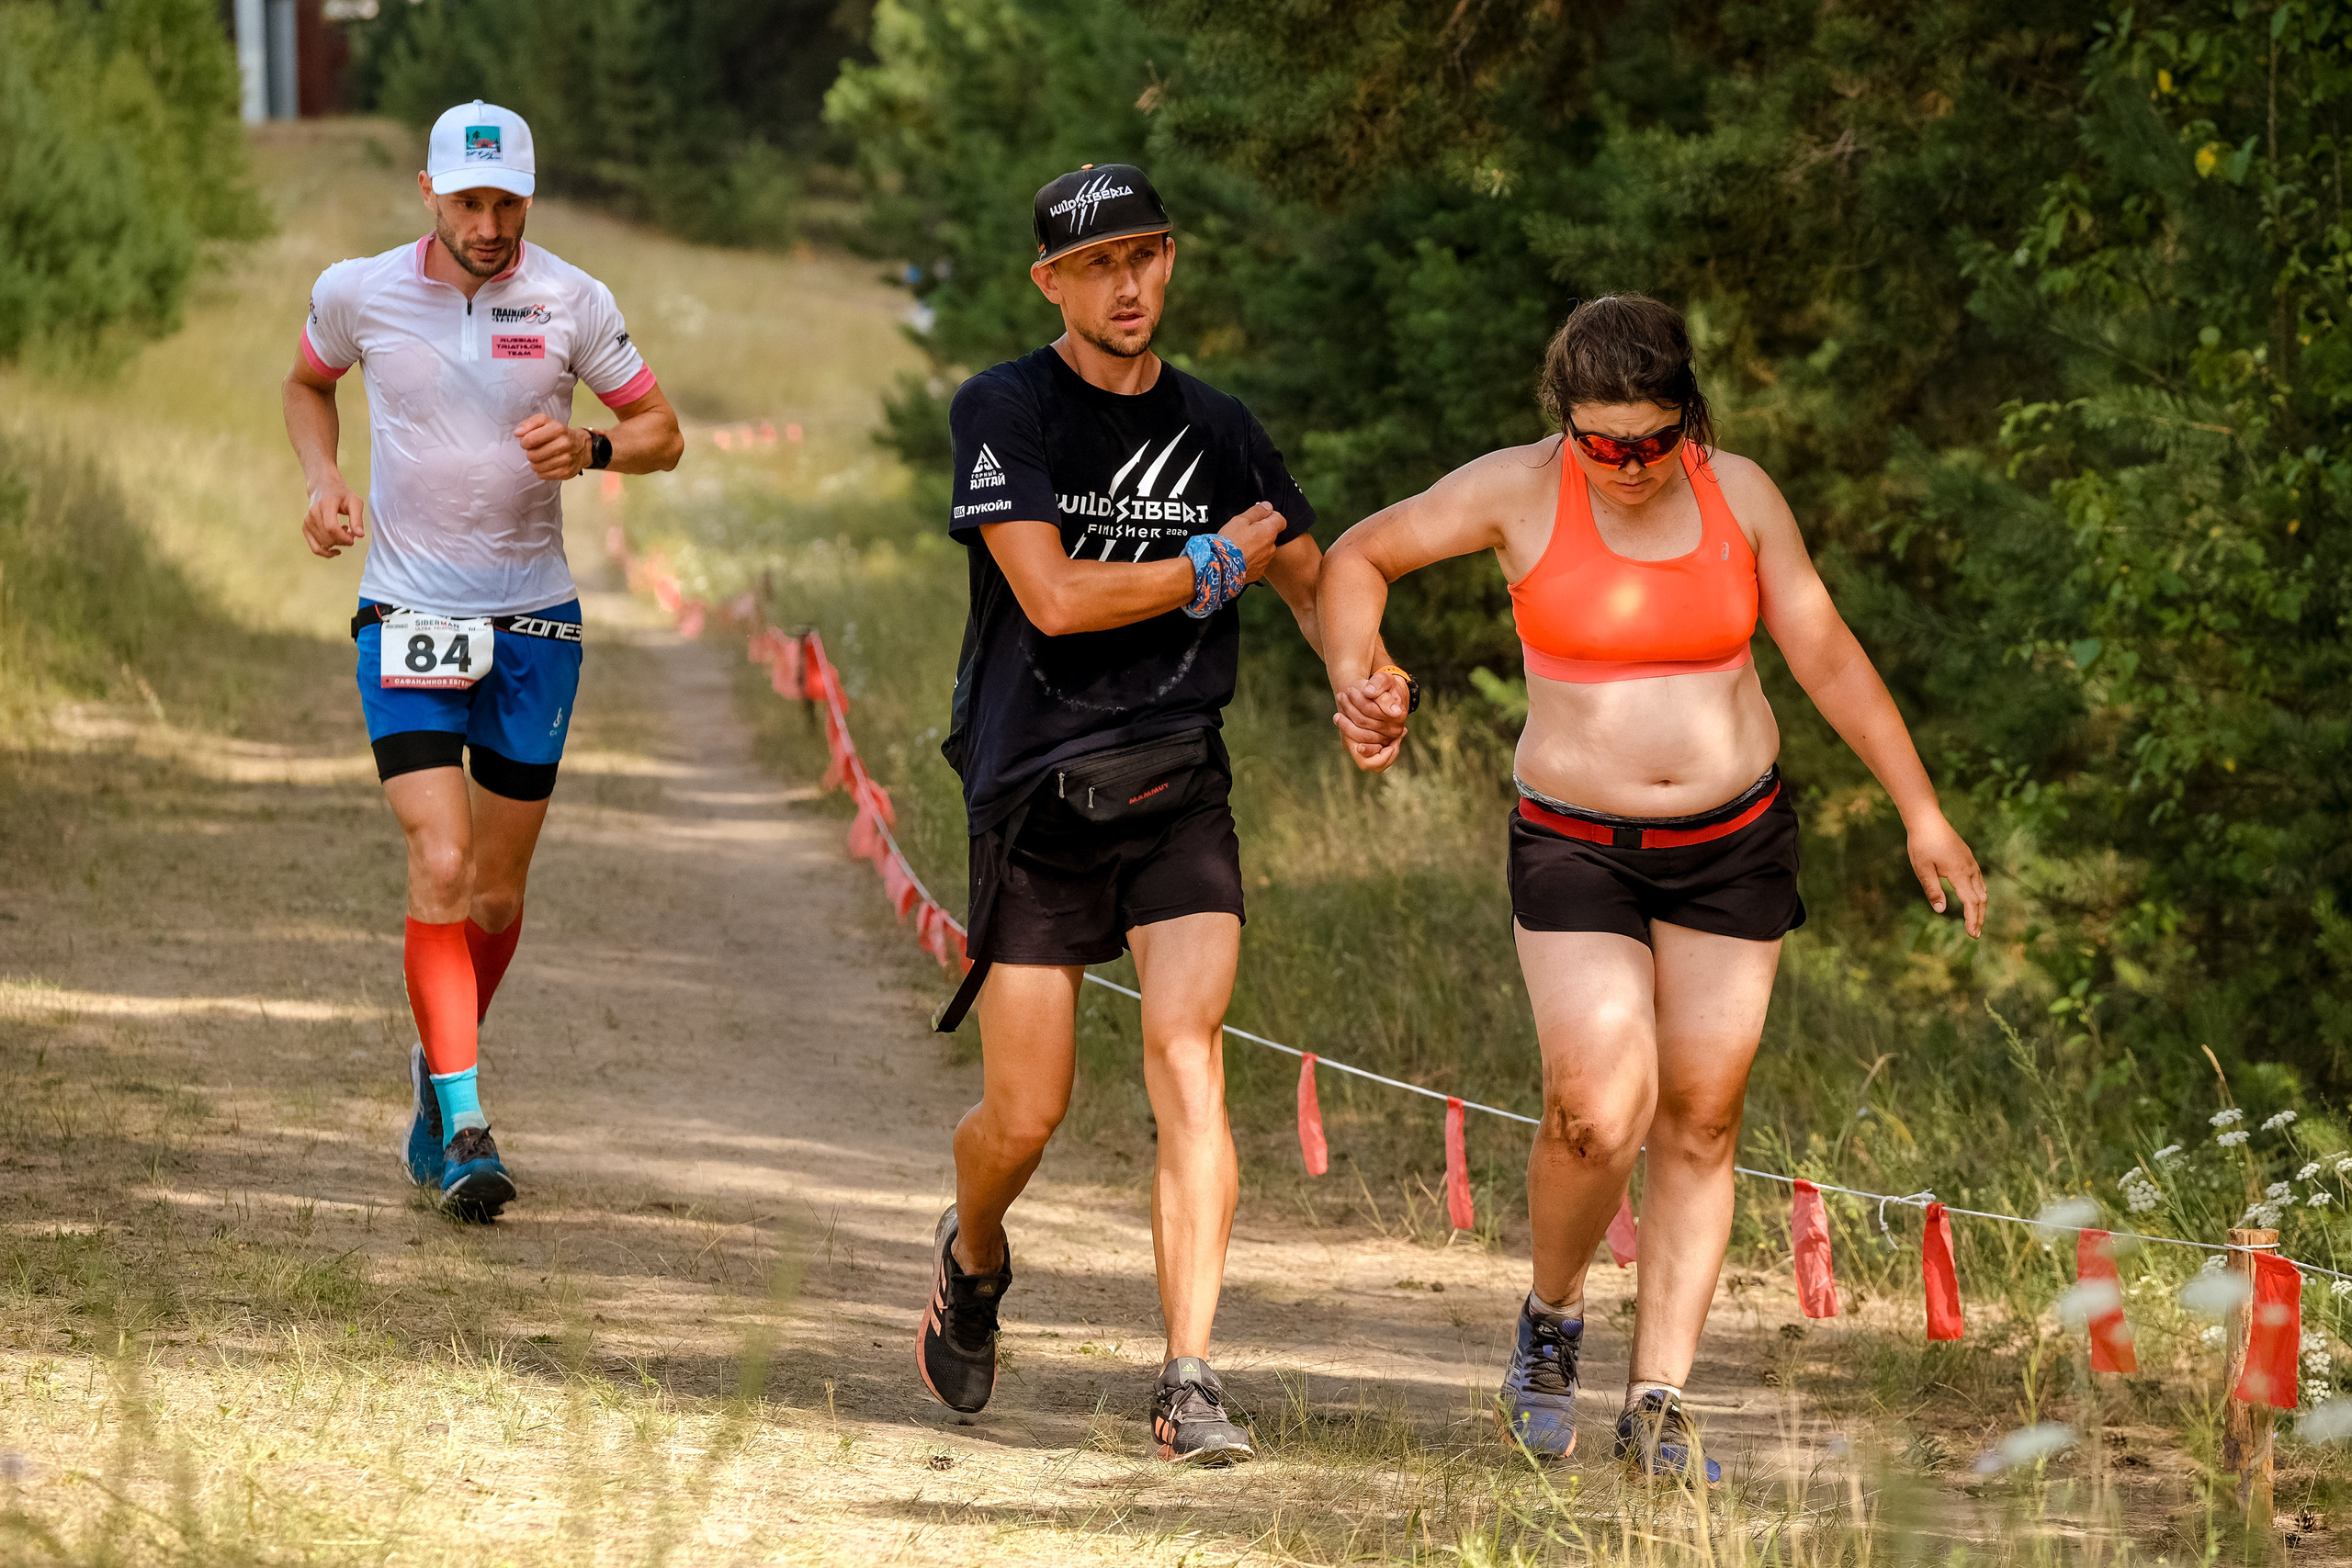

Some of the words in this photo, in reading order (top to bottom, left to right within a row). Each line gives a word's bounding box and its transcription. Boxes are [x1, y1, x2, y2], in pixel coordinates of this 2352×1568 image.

[970, 472, 1006, 491] АЛТАЙ
[971, 469, 997, 479] ГОРНЫЙ
[967, 499, 1012, 515] ЛУКОЙЛ
[1115, 495, 1209, 524] SIBERI
[1166, 528, 1188, 536] 2020
[415, 619, 459, 629] SIBERMAN
[404, 633, 472, 673] 84
[1129, 782, 1170, 805] MAMMUT
